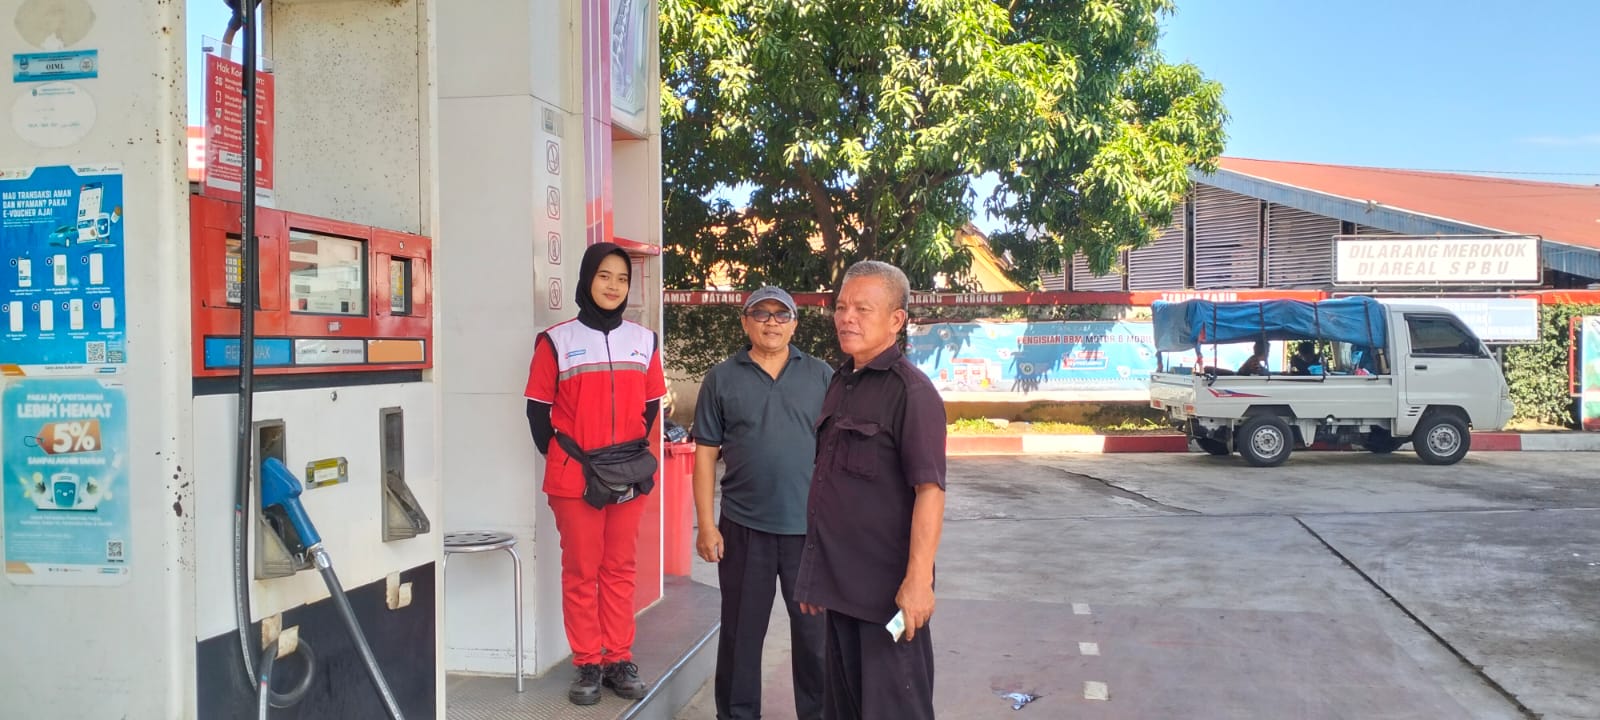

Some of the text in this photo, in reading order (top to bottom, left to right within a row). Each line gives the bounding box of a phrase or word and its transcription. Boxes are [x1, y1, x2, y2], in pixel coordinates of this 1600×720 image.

[216, 61, 230, 74] Hak
[2, 189, 72, 200] MAU TRANSAKSI AMAN
[3, 198, 68, 209] DAN NYAMAN? PAKAI
[3, 208, 36, 218] E-VOUCHER
[1349, 242, 1527, 259] DILARANG MEROKOK
[1357, 261, 1375, 276] DI
[1378, 261, 1437, 276] AREAL
[701, 293, 742, 303] DATANG
[955, 293, 1004, 304] MEROKOK
[1017, 335, 1061, 345] PENGISIAN
[1063, 335, 1082, 344] BBM
[1085, 335, 1115, 344] MOTOR
[17, 403, 112, 418] LEBIH HEMAT
[52, 421, 95, 453] 5%
